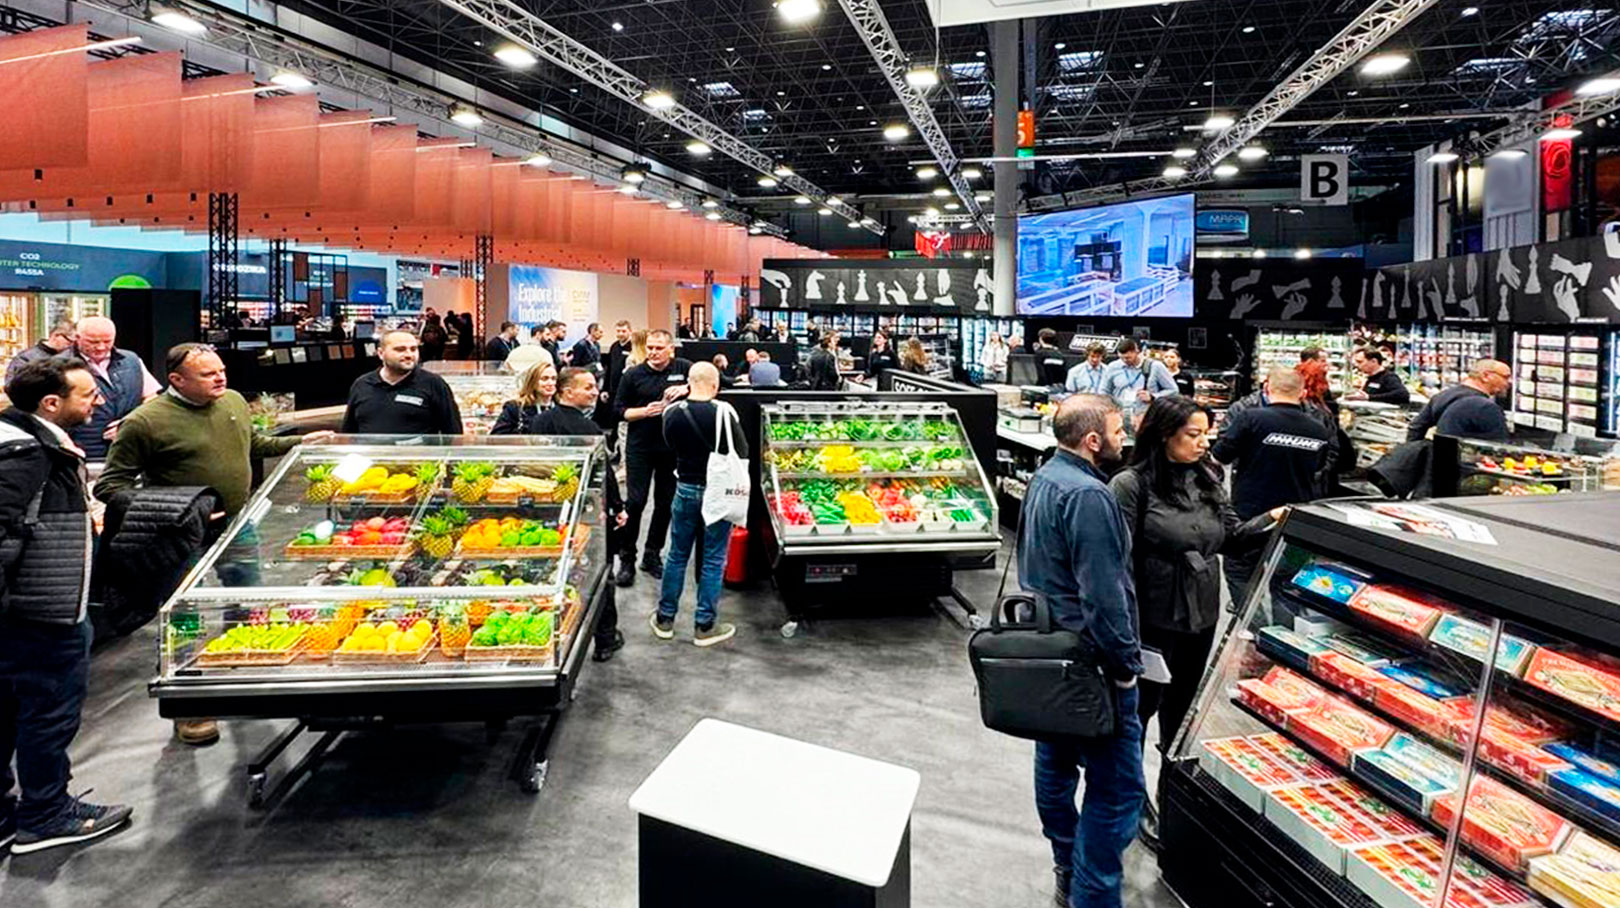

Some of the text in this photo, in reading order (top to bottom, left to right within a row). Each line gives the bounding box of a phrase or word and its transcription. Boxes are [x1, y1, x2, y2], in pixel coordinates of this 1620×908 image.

[1310, 161, 1339, 198] B
[19, 252, 40, 261] CO2
[21, 260, 80, 271] TECHNOLOGY
[519, 282, 551, 306] Explore
